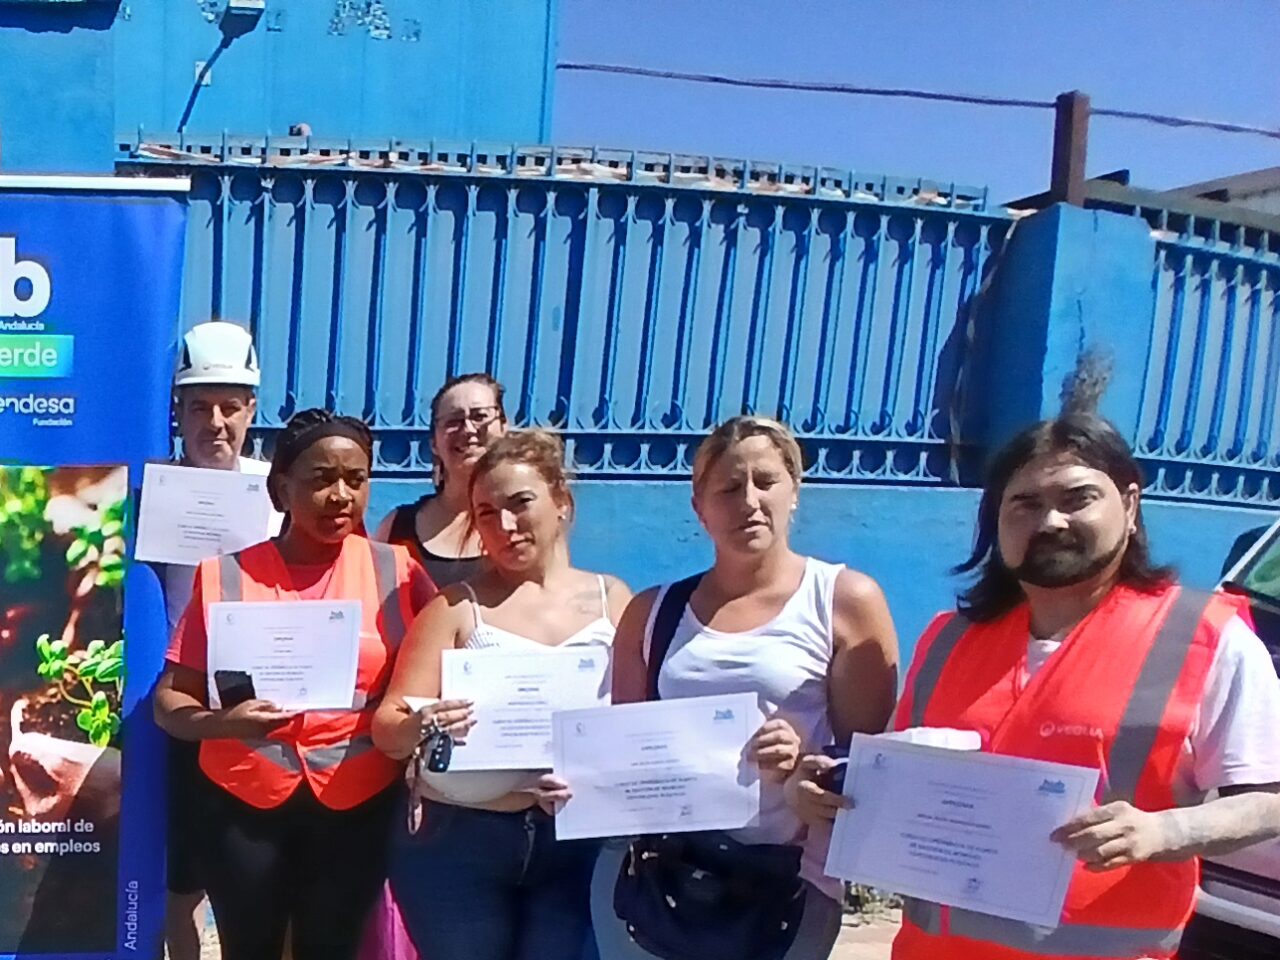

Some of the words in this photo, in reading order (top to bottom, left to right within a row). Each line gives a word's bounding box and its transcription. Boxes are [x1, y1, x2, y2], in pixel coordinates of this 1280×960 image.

[18, 818, 72, 834] laboral
[74, 818, 95, 832] de
[12, 842, 32, 854] en
[35, 839, 101, 856] empleos
[124, 880, 138, 951] Andalucía
